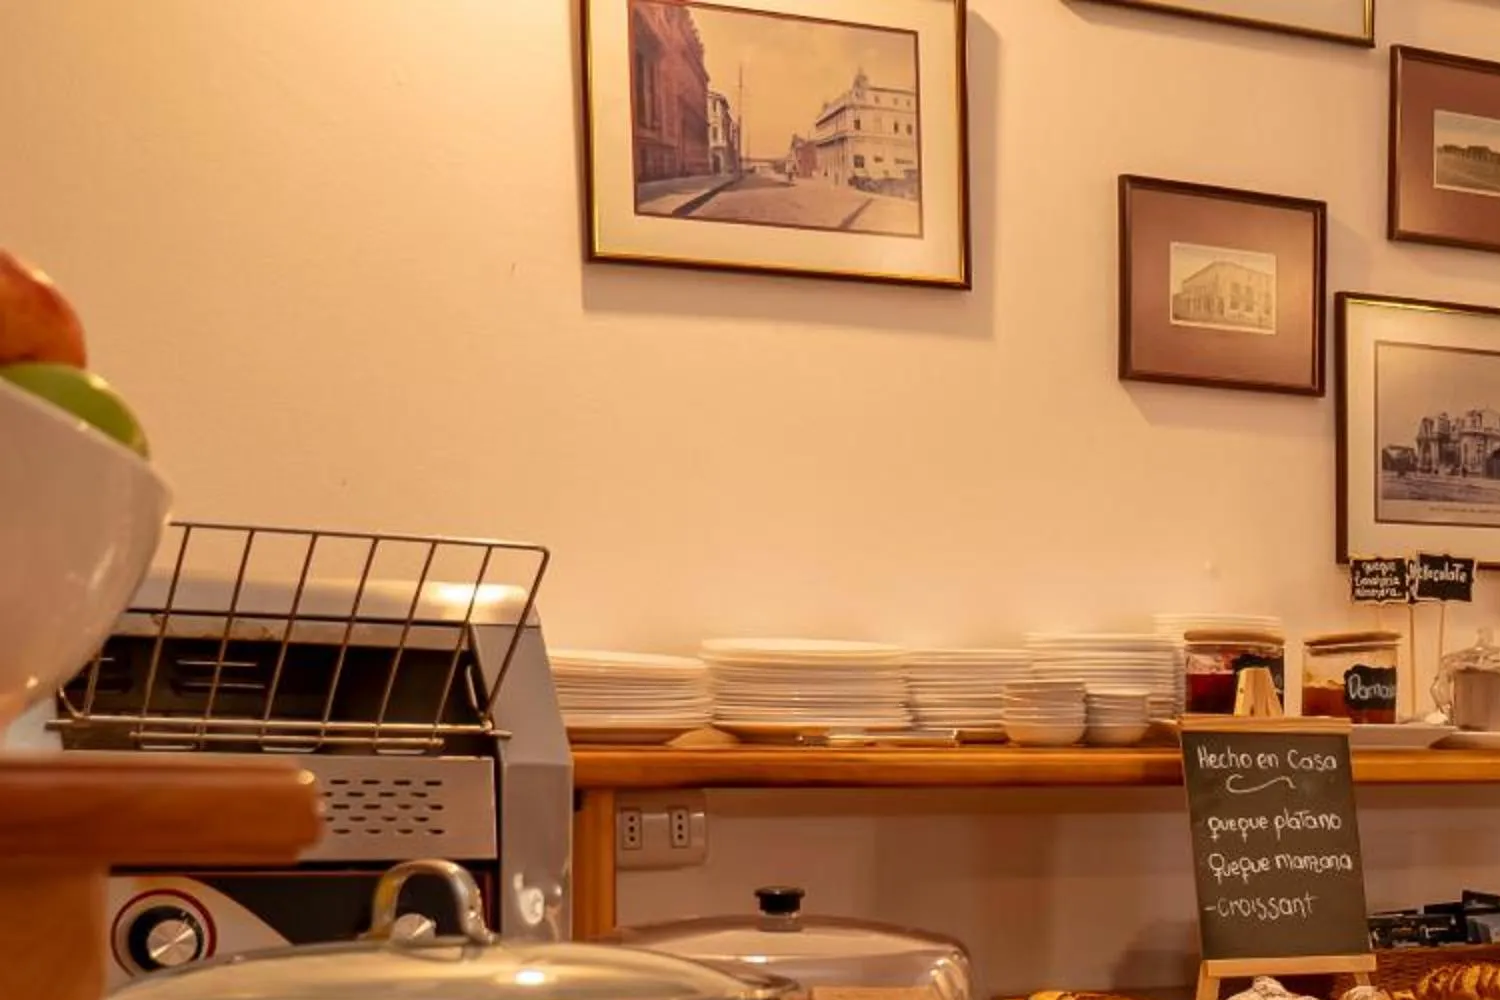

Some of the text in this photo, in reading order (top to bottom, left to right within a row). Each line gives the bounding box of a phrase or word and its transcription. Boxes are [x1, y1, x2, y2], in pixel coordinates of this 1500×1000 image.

[1197, 746, 1338, 772] Hecho en Casa
